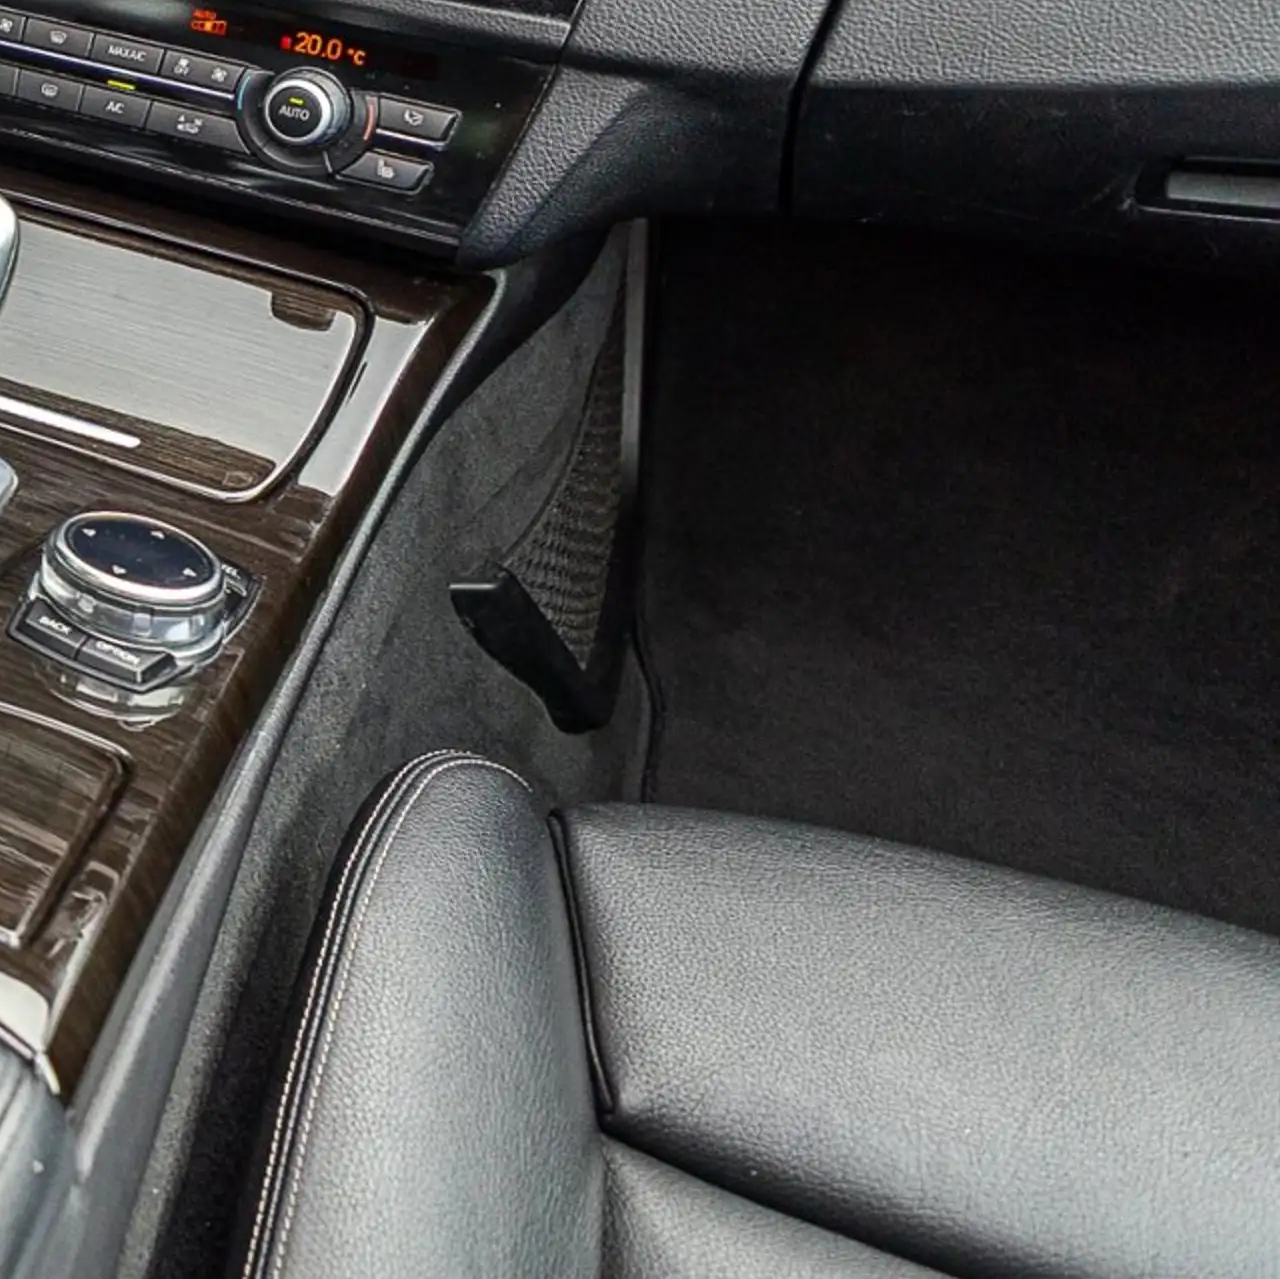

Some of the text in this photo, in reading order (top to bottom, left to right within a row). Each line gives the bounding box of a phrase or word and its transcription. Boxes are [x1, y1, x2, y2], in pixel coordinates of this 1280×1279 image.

[295, 32, 343, 61] 20.0
[279, 105, 311, 121] AUTO
[39, 615, 72, 636] BACK
[95, 640, 141, 665] OPTION
